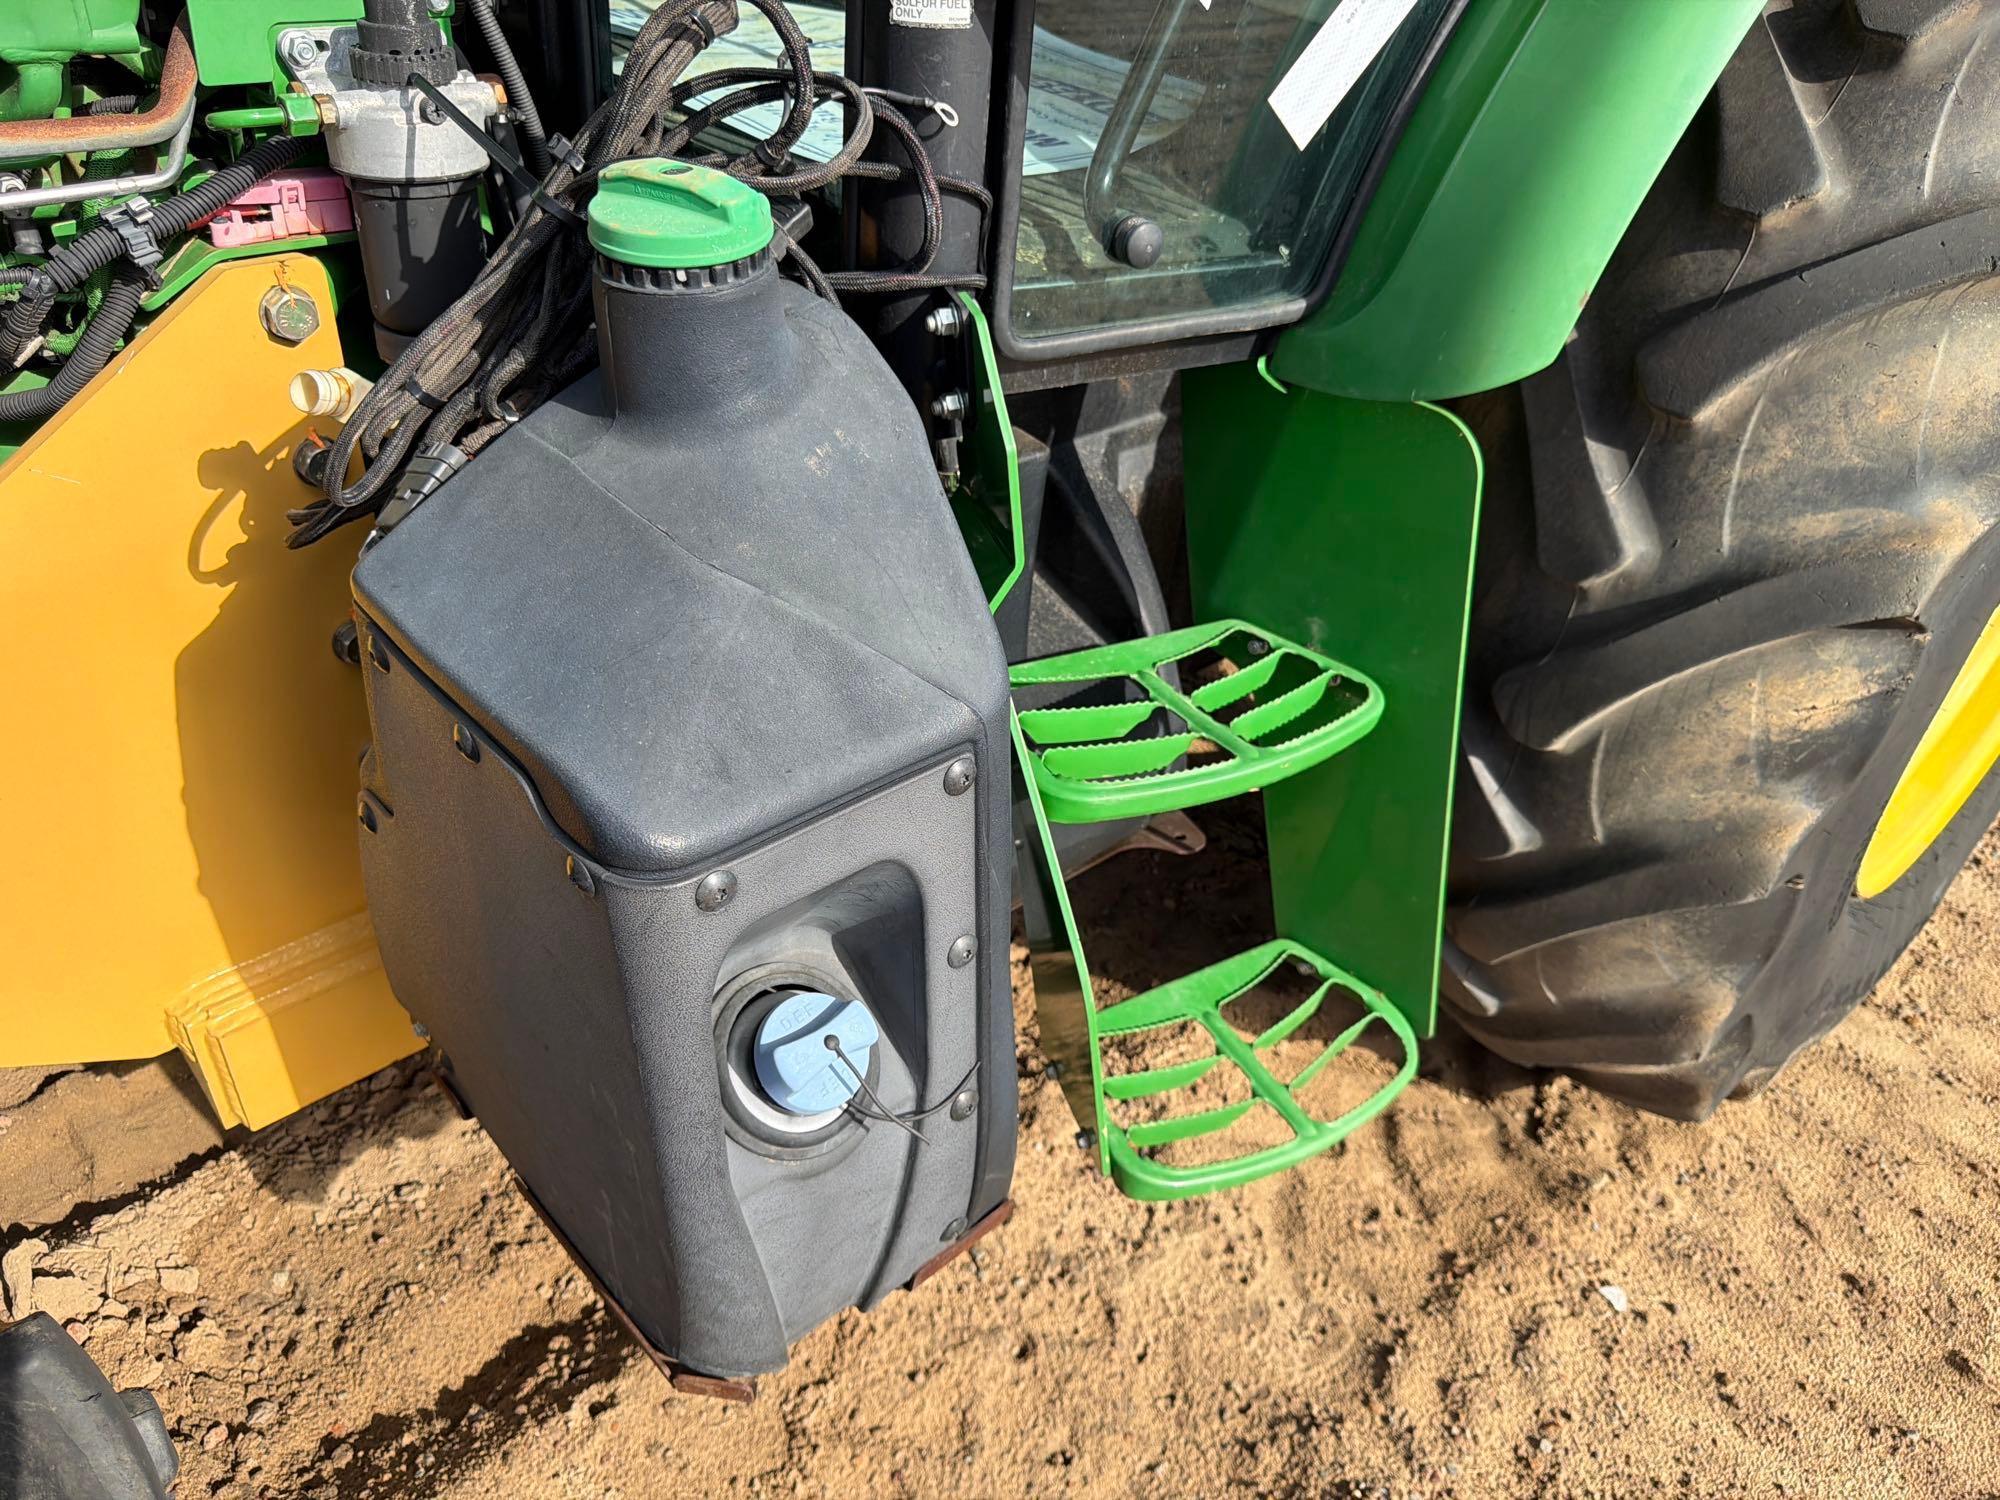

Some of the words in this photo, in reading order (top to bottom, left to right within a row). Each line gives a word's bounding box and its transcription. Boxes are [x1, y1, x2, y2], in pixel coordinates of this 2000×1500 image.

[940, 0, 967, 9] FUEL
[895, 7, 923, 19] ONLY
[780, 1003, 816, 1031] DEF
